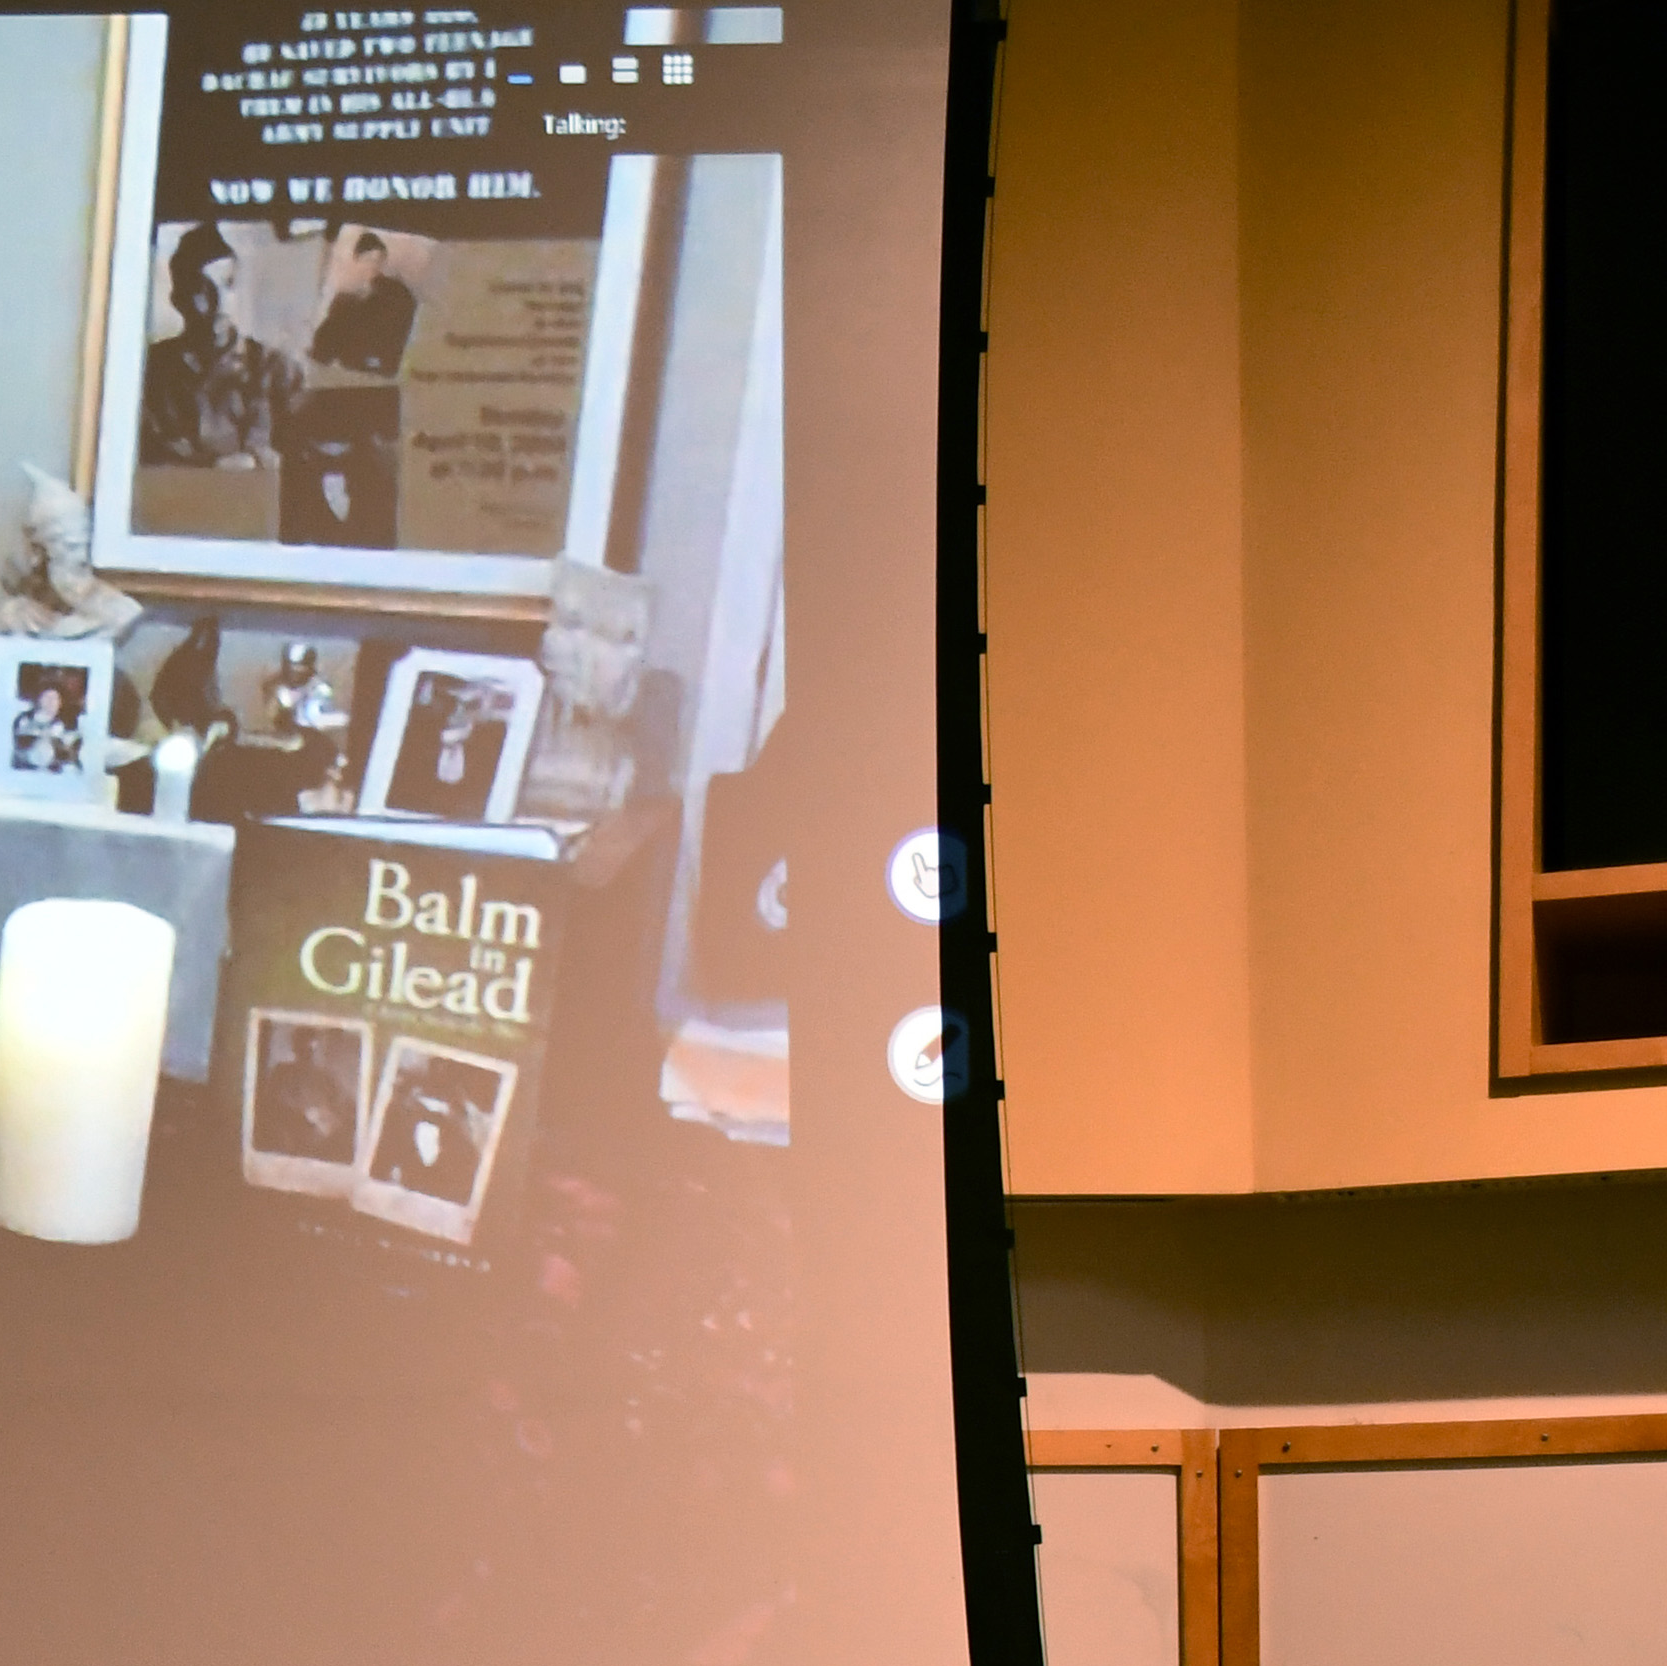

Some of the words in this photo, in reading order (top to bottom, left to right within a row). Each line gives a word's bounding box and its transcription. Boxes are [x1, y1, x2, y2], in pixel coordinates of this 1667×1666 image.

[543, 113, 626, 140] Talking:
[210, 178, 275, 204] NOW
[288, 177, 332, 203] WE
[343, 173, 457, 201] HONOR
[364, 858, 541, 949] Balm
[469, 941, 506, 973] in
[299, 926, 533, 1023] Gilead
